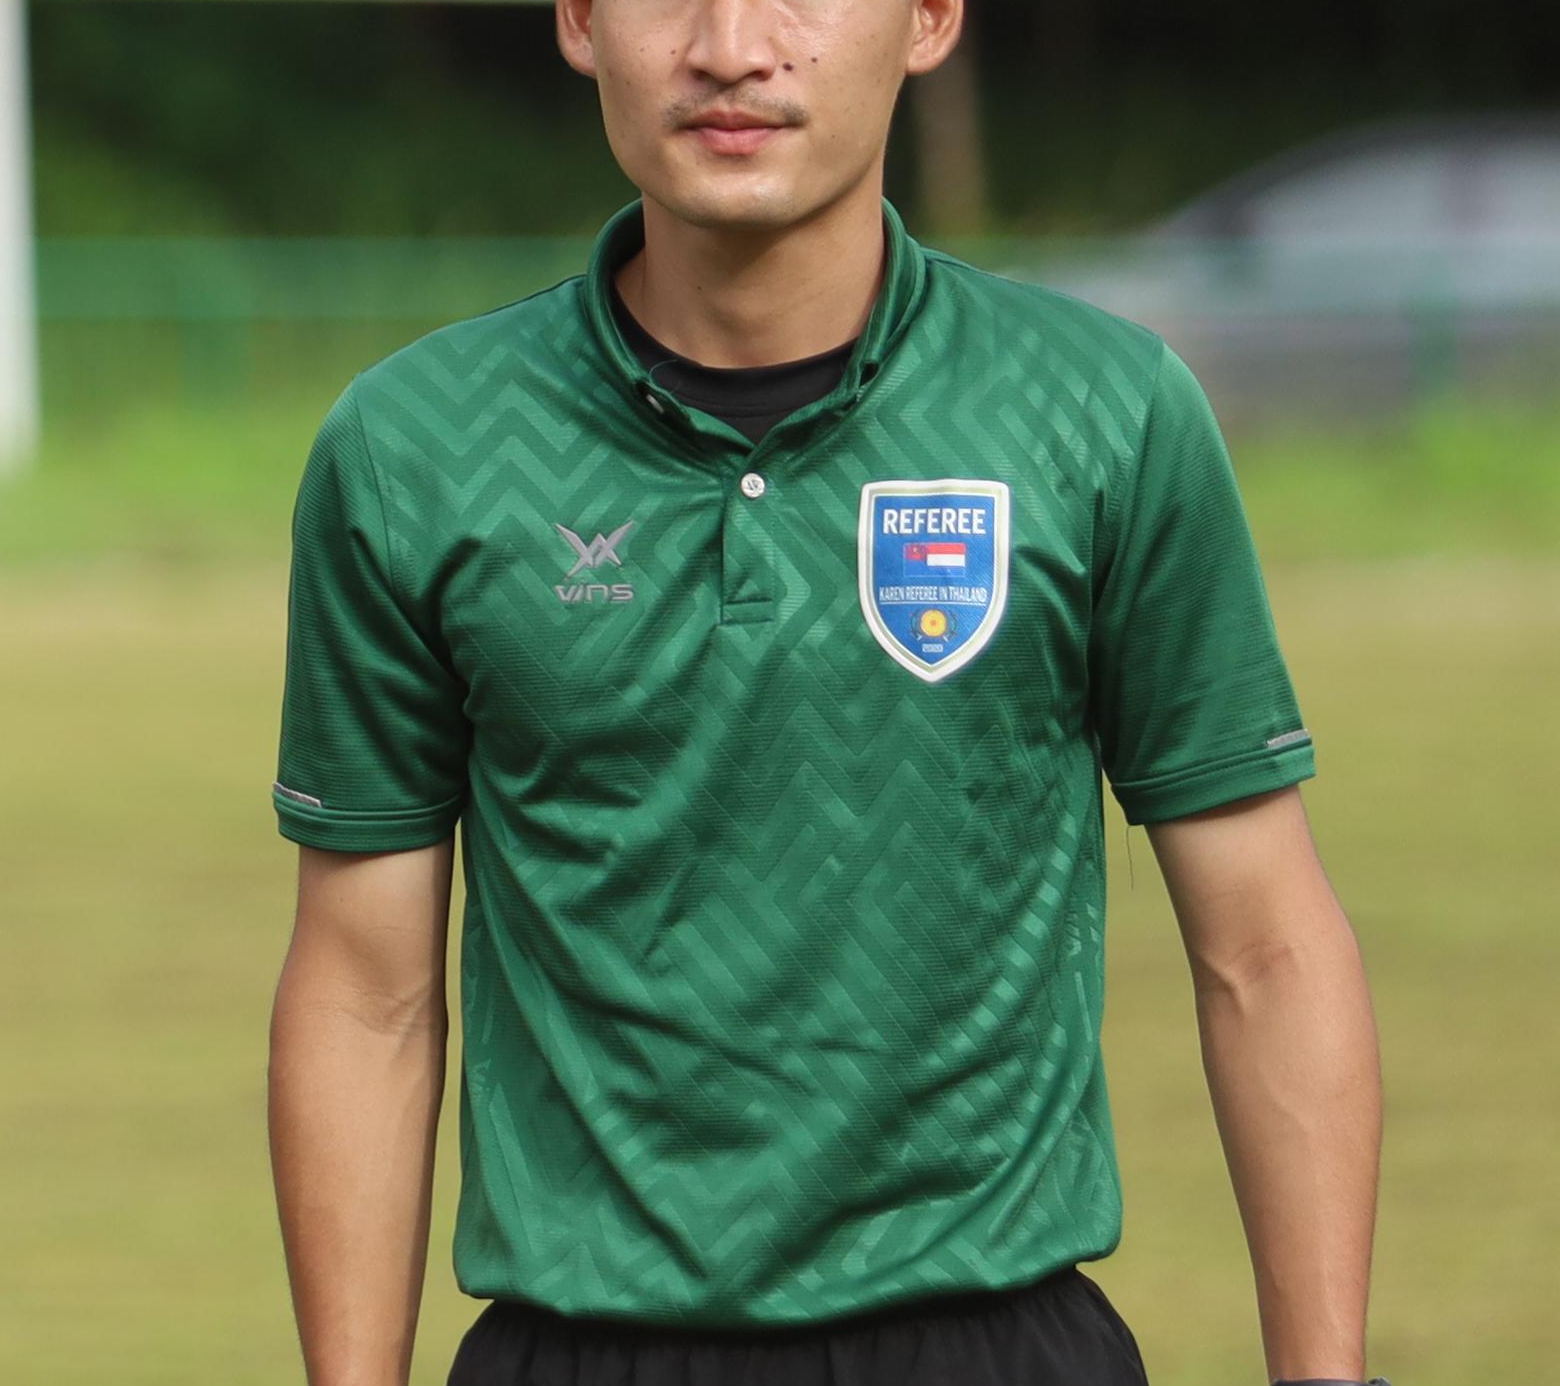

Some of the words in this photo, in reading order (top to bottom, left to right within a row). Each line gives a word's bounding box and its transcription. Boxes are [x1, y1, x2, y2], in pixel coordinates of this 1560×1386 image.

[883, 508, 986, 534] REFEREE
[879, 586, 904, 601] KAREN
[906, 586, 938, 601] REFEREE
[939, 586, 948, 601] IN
[949, 586, 988, 603] THAILAND
